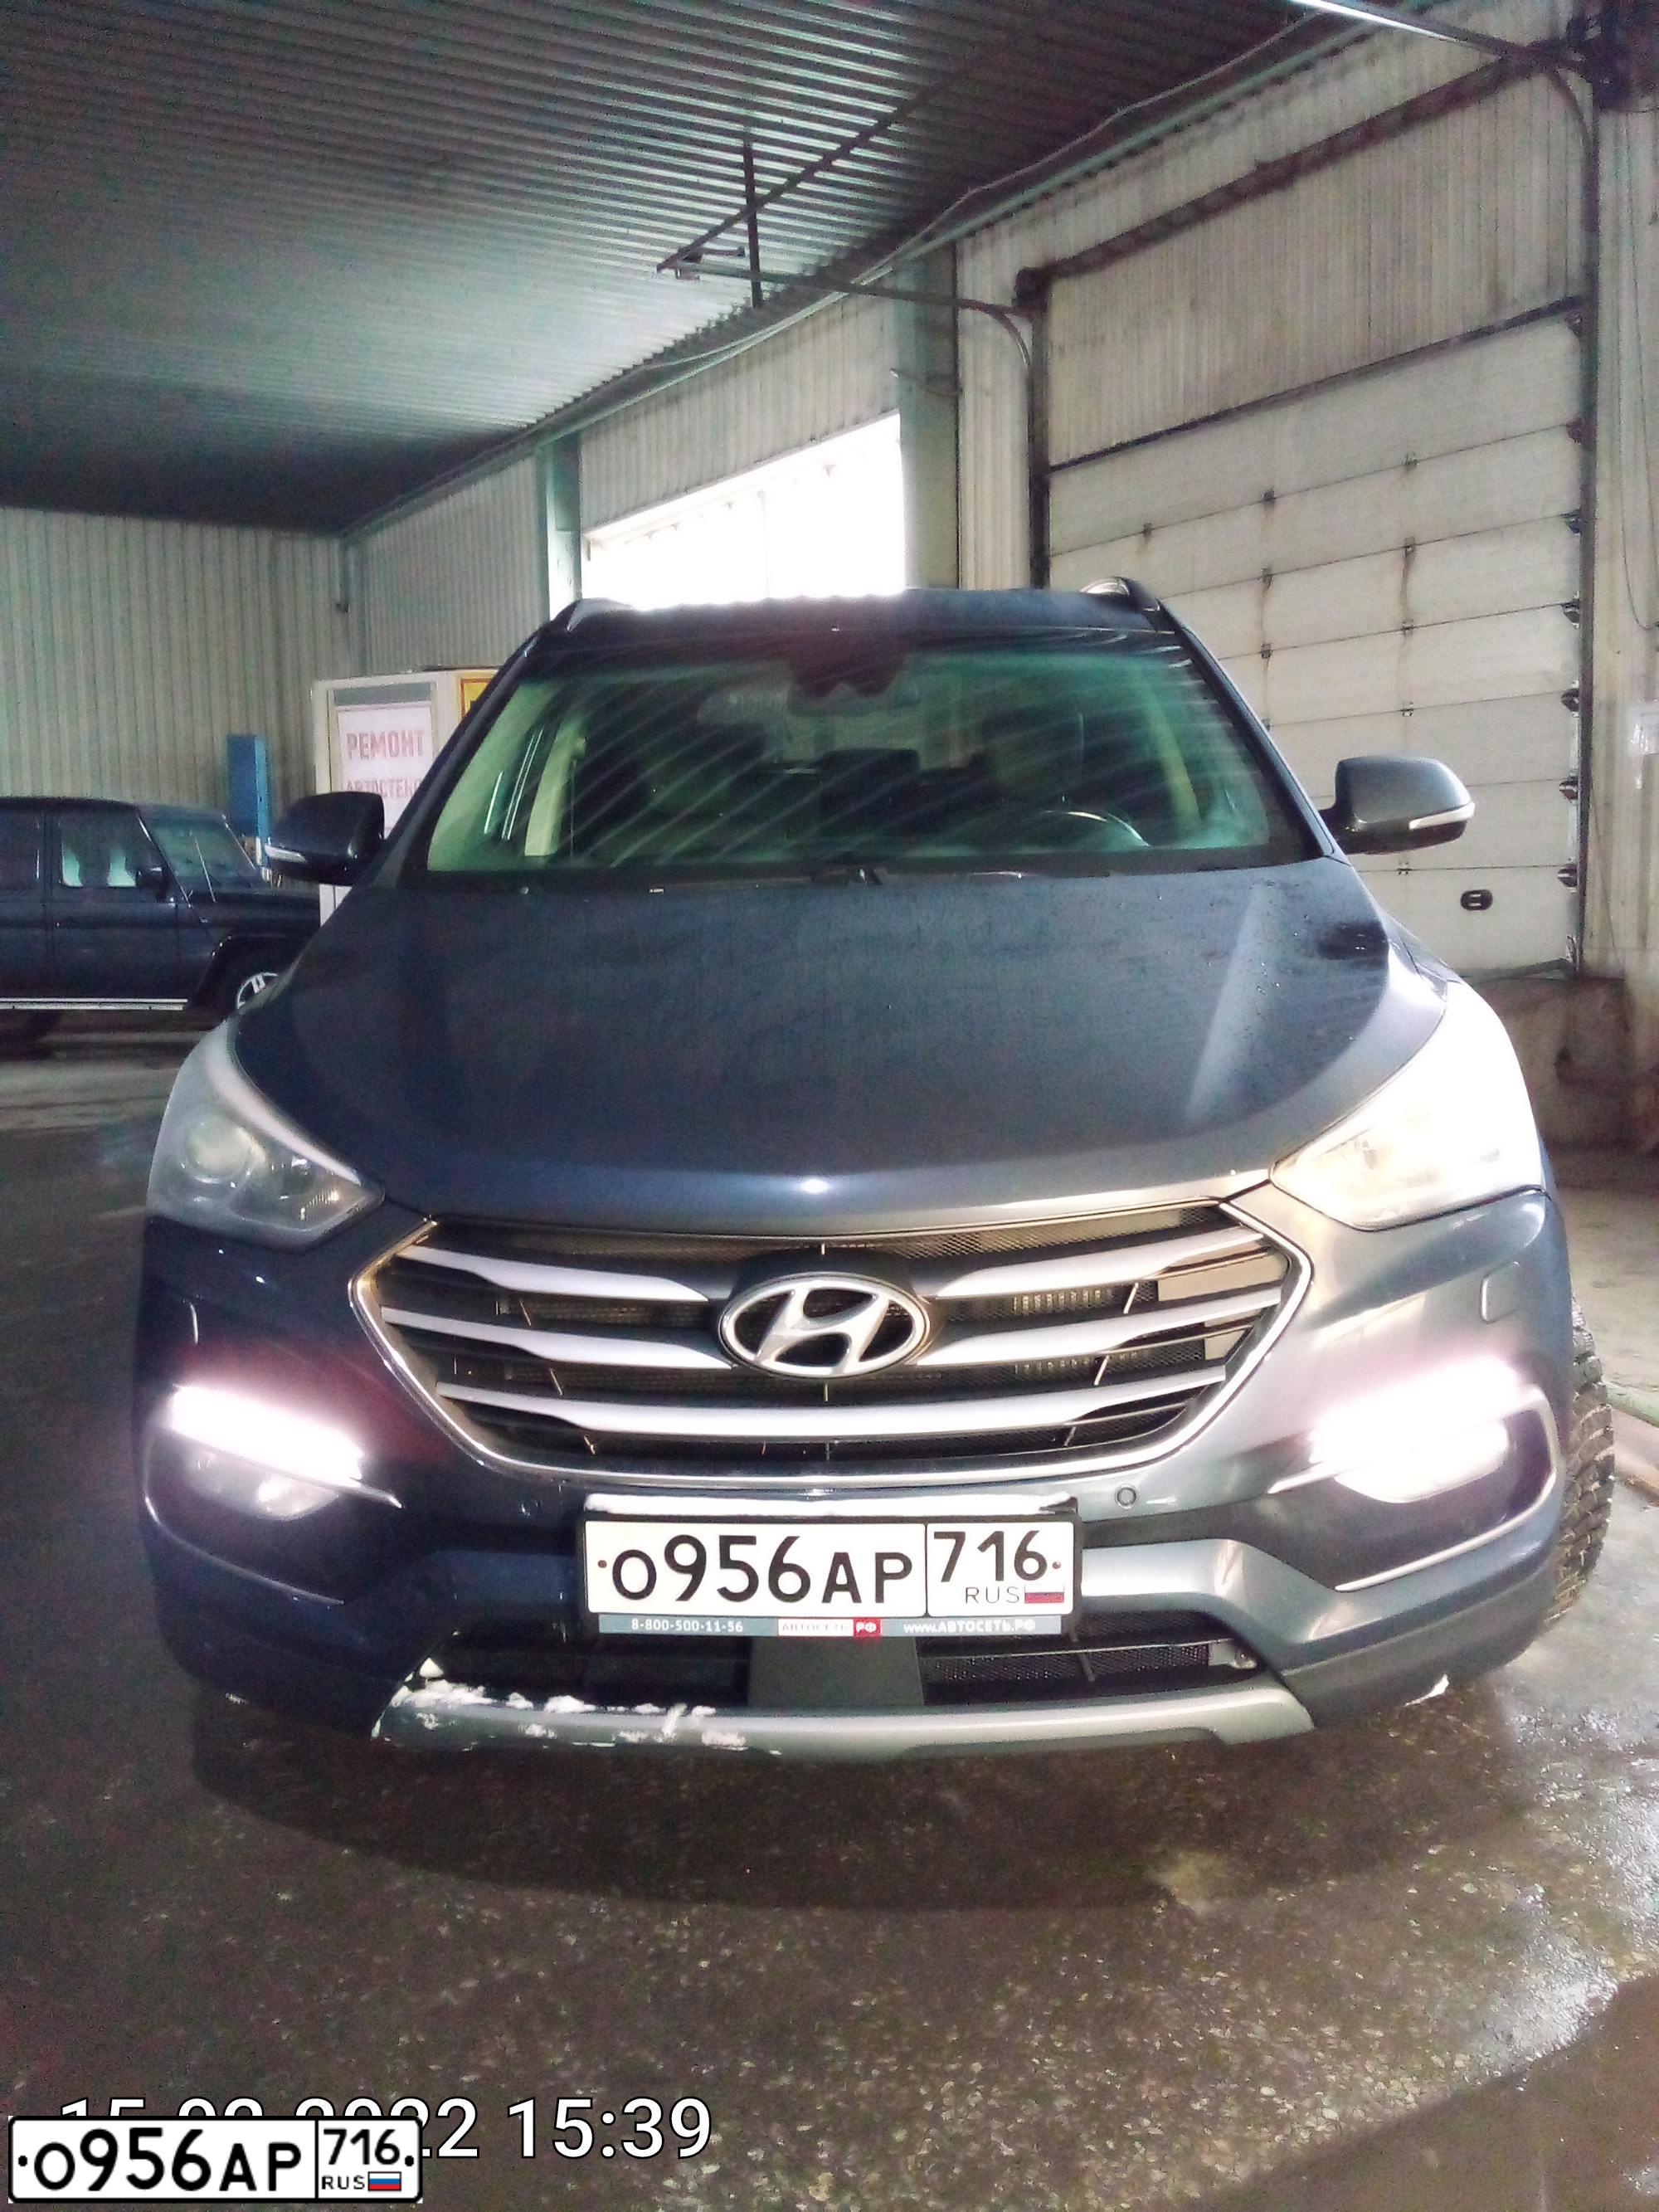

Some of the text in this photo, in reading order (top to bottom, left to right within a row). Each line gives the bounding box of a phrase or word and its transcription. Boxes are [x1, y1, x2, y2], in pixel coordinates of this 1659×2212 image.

[346, 730, 425, 759] РЕМОНТ
[933, 1529, 1048, 1583] 716
[966, 1586, 1020, 1604] RUS
[630, 1618, 744, 1633] 8-800-500-11-56
